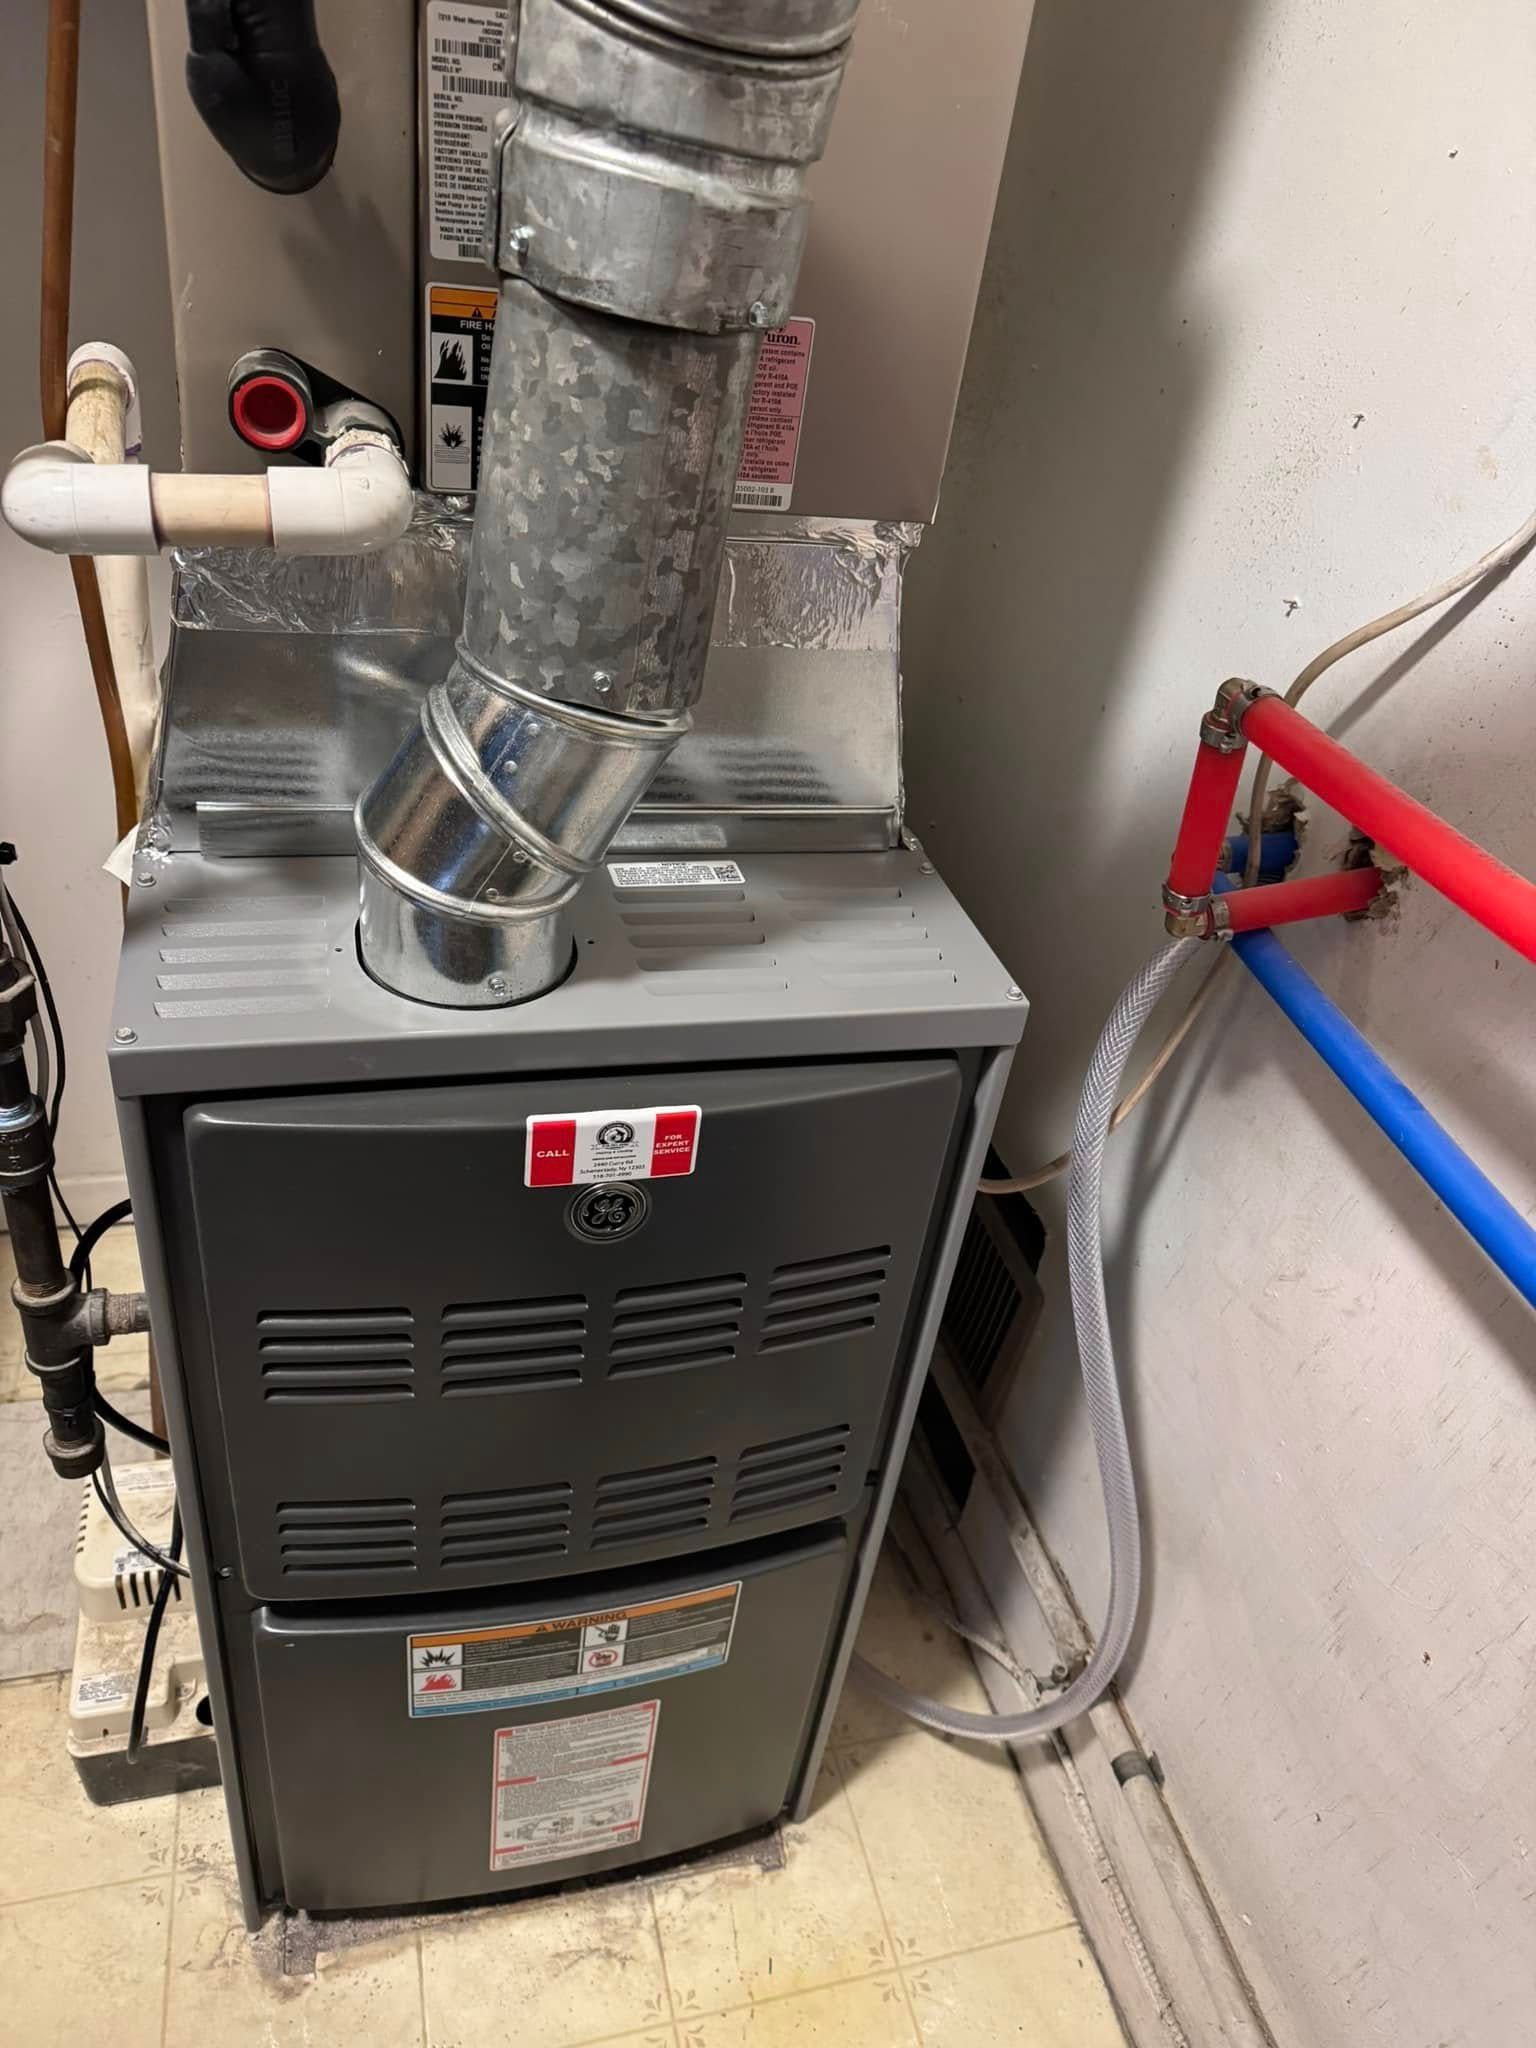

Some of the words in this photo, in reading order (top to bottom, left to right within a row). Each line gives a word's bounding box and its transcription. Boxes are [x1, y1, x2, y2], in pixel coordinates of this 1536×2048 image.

[460, 319, 483, 329] FIRE
[655, 1140, 690, 1148] EXPERT
[536, 1149, 570, 1158] CALL
[653, 1146, 692, 1156] SERVICE
[552, 1611, 628, 1630] WARNING
